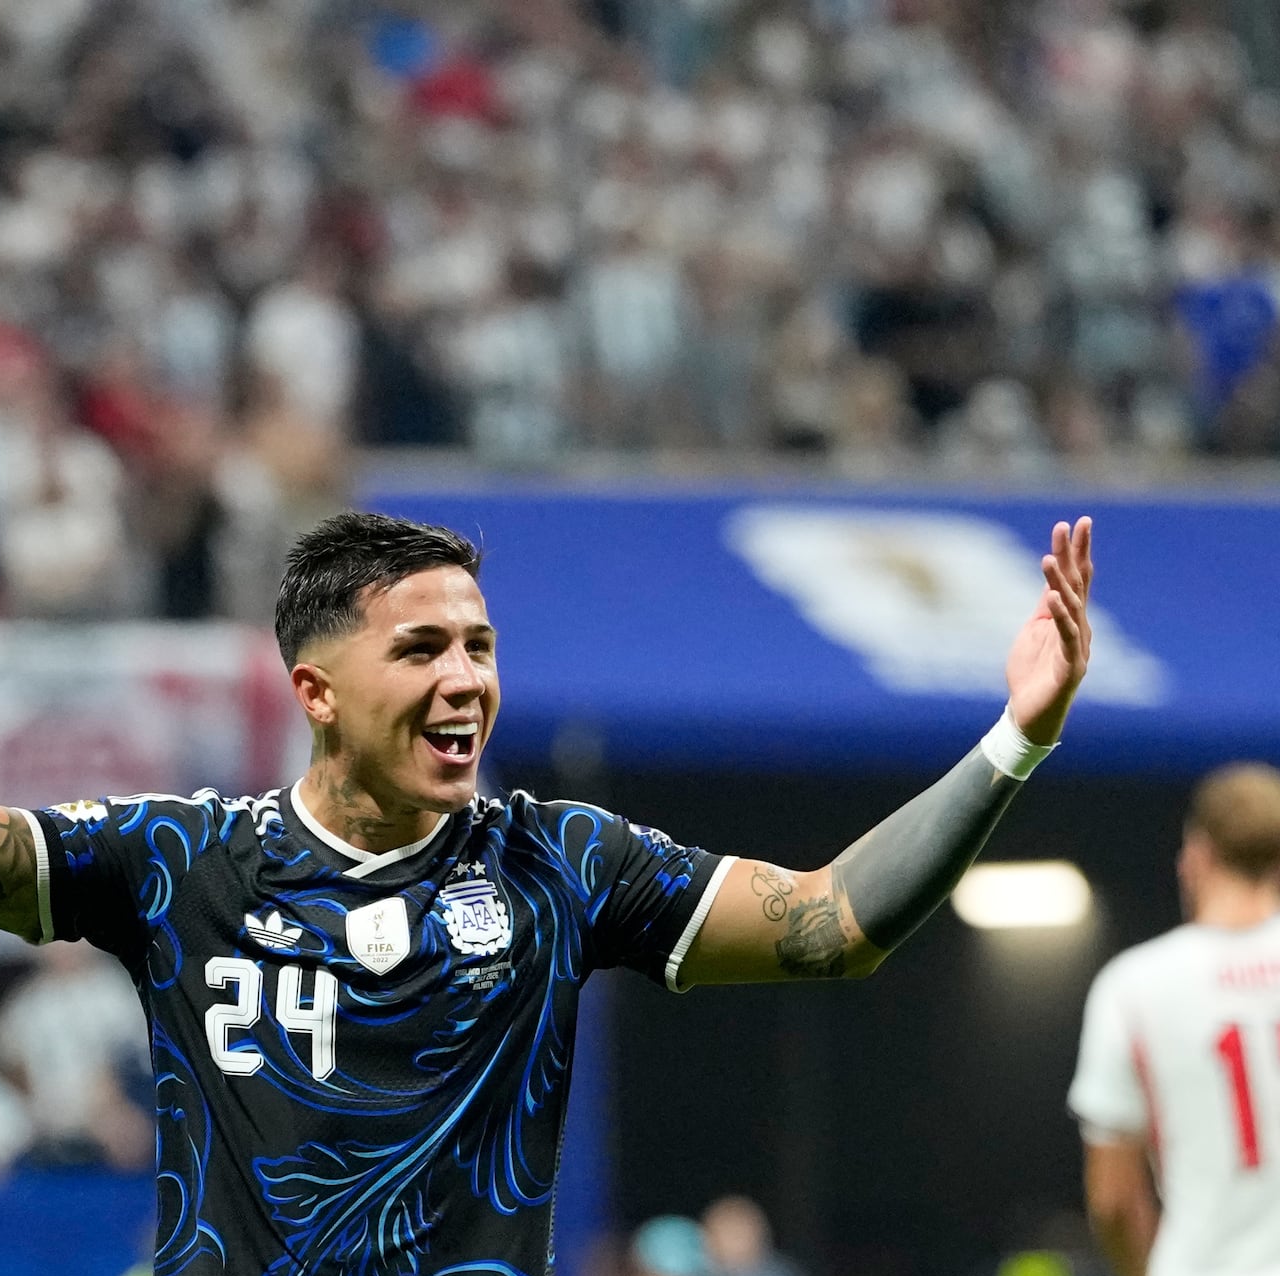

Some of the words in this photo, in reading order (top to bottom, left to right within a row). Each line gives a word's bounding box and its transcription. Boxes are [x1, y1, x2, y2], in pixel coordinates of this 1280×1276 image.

[460, 899, 496, 932] AFA
[366, 943, 394, 953] FIFA
[372, 956, 389, 964] 2022
[205, 956, 338, 1082] 24
